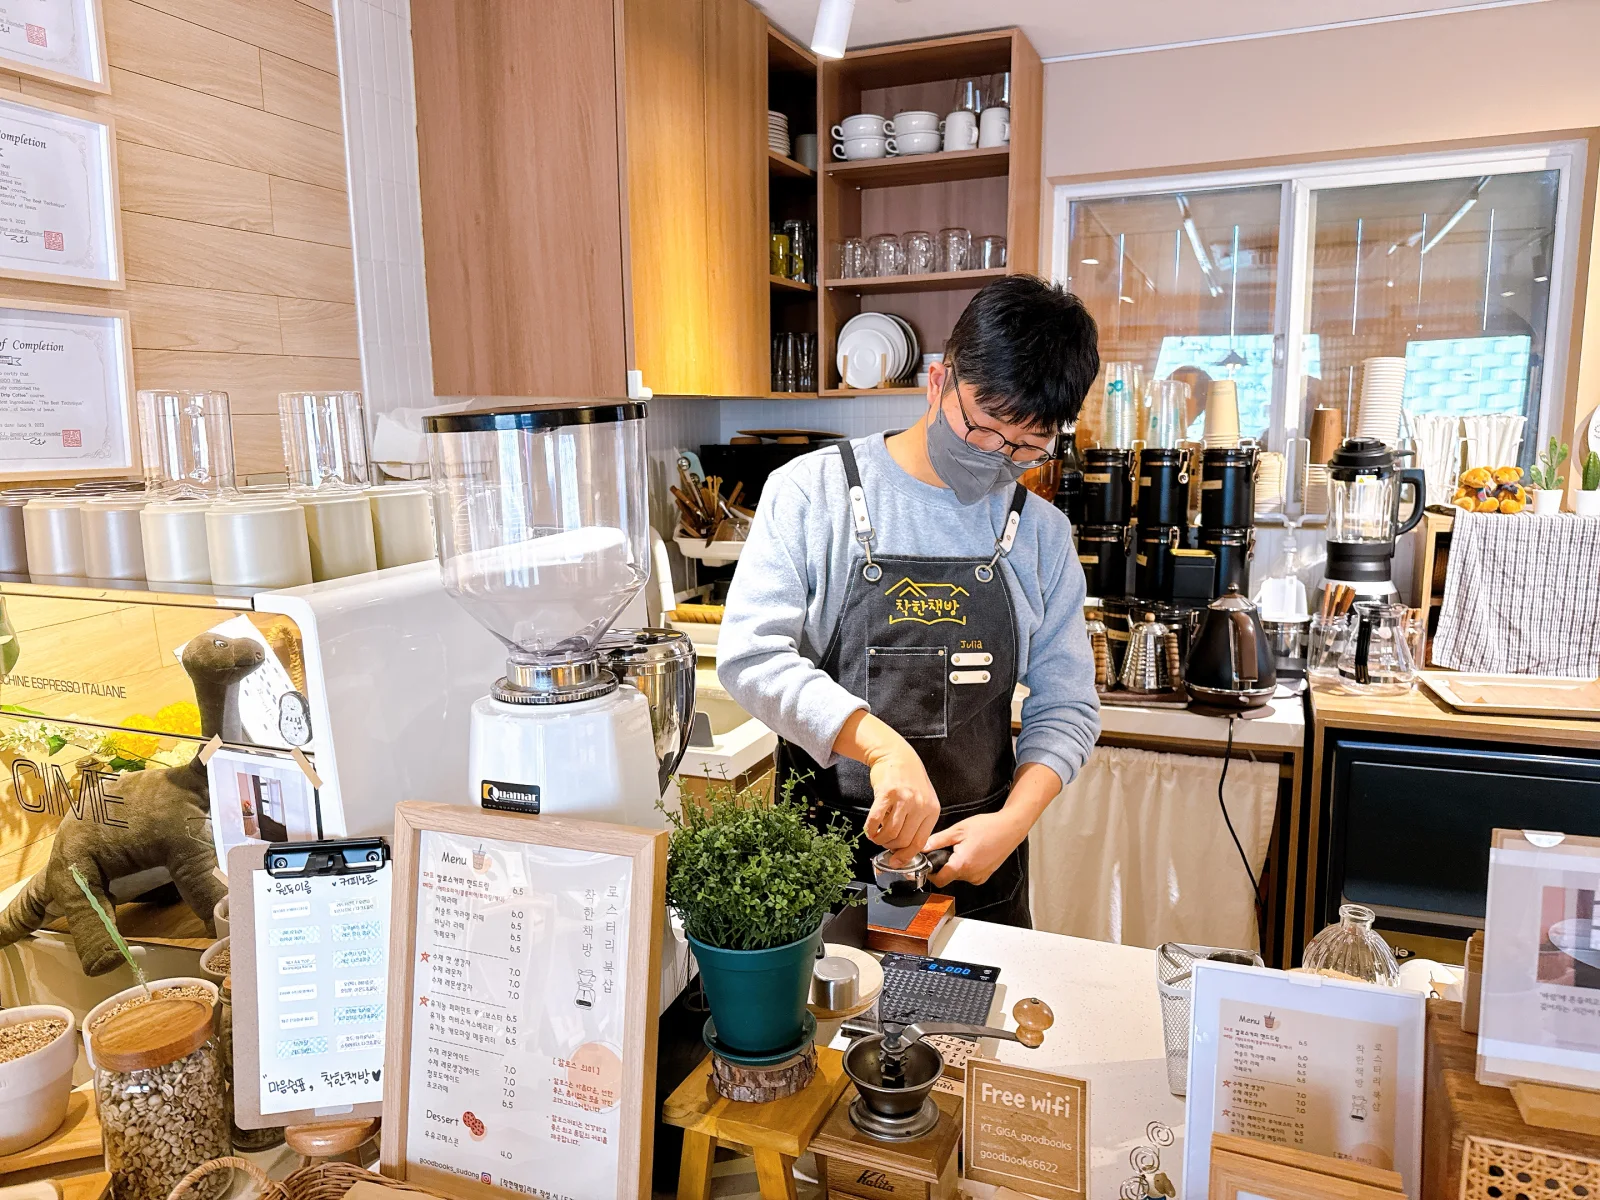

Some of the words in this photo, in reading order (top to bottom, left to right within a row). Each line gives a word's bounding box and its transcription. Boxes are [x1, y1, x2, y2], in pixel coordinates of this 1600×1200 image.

[0, 130, 47, 149] ompletion
[13, 340, 64, 353] Completion
[895, 598, 960, 617] 착한책방
[960, 640, 983, 649] Julia
[31, 676, 80, 693] ESPRESSO
[81, 682, 126, 698] ITALIANE
[11, 758, 129, 830] CIME
[485, 783, 538, 803] Quamar
[441, 852, 467, 866] Menu
[275, 880, 312, 895] 원두이름
[339, 874, 378, 887] 커피노트
[466, 879, 490, 891] 핸드드립
[512, 887, 524, 896] 6.5
[435, 895, 458, 905] 카페라떼
[511, 910, 524, 919] 6.0
[434, 918, 451, 928] 바닐라
[453, 920, 465, 930] 라떼
[510, 933, 521, 942] 6.5
[454, 909, 470, 921] 카라멜
[472, 912, 485, 922] 라떼
[511, 922, 522, 930] 6.5
[582, 888, 597, 958] 착한책방
[604, 885, 618, 954] 로스터리
[433, 930, 456, 940] 카페모카
[509, 945, 521, 954] 6.5
[432, 965, 443, 974] 수제
[445, 967, 463, 977] 레몬차
[508, 980, 521, 988] 7.0
[433, 954, 444, 962] 수제
[454, 957, 471, 968] 생강차
[508, 968, 521, 977] 7.0
[431, 977, 443, 985] 수제
[444, 979, 473, 992] 레몬생강차
[507, 991, 520, 1000] 7.0
[430, 1000, 446, 1011] 유기농
[449, 1004, 472, 1015] 페퍼민트
[506, 1014, 517, 1023] 6.5
[430, 1011, 446, 1023] 유기농
[506, 1025, 517, 1034] 6.5
[1239, 1015, 1260, 1026] Menu
[429, 1023, 445, 1035] 유기농
[505, 1036, 517, 1046] 6.5
[428, 1046, 439, 1055] 수제
[441, 1049, 470, 1062] 레몬에이드
[504, 1065, 517, 1075] 7.0
[1297, 1061, 1307, 1069] 6.5
[320, 1068, 371, 1088] 착한책방
[427, 1058, 438, 1067] 수제
[441, 1060, 480, 1077] 레몬생강에이드
[503, 1077, 516, 1087] 7.0
[427, 1069, 460, 1084] 청포도에이드
[503, 1088, 515, 1098] 7.0
[1297, 1069, 1307, 1077] 6.5
[426, 1081, 449, 1093] 초코라떼
[502, 1100, 513, 1109] 6.5
[981, 1083, 1025, 1109] Free
[1031, 1092, 1070, 1119] wifi
[1295, 1099, 1306, 1107] 7.0
[426, 1109, 459, 1126] Dessert
[980, 1123, 1072, 1151] KT_GIGA_goodbooks
[1294, 1129, 1304, 1137] 6.5
[500, 1150, 513, 1160] 4.0
[980, 1150, 1058, 1174] goodbooks6622
[419, 1158, 480, 1180] goodbooks_sudong
[856, 1169, 895, 1193] Kalita
